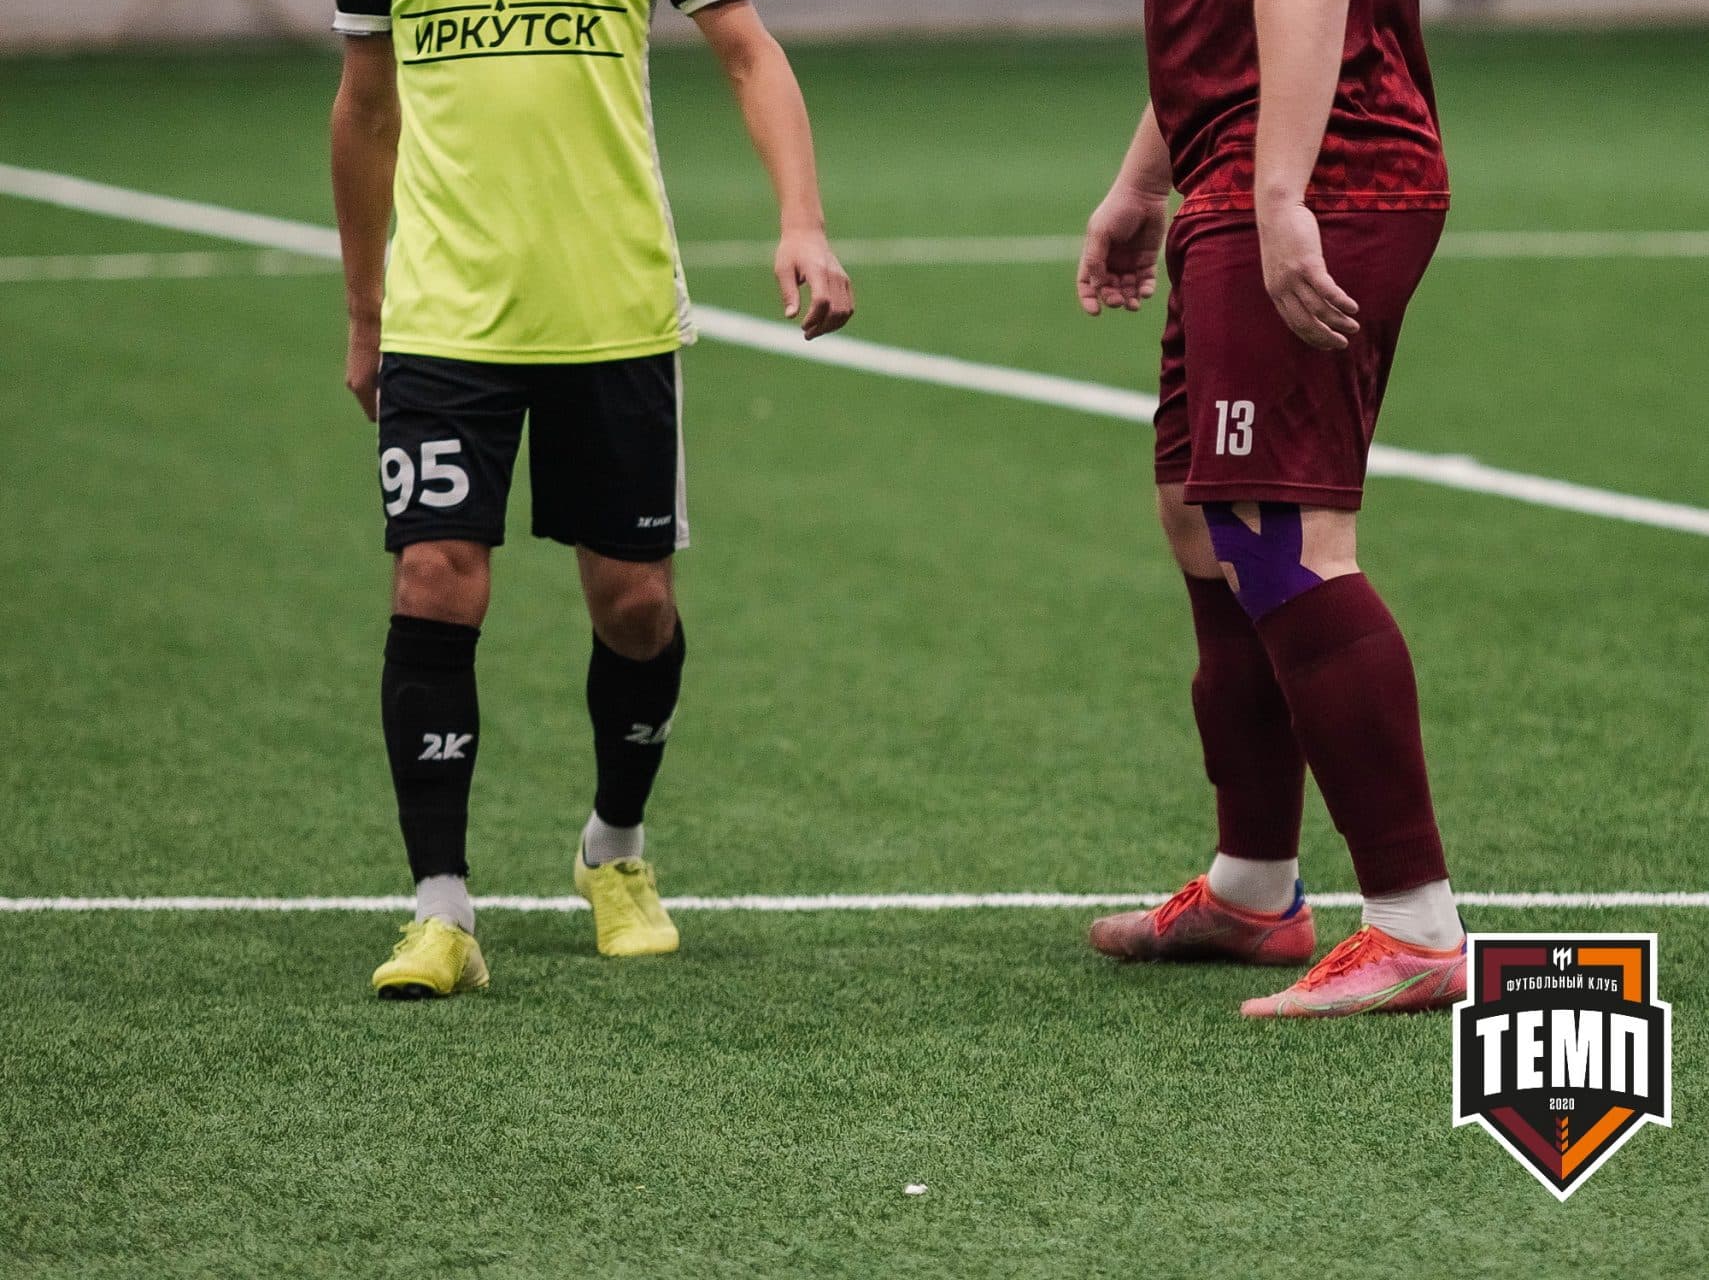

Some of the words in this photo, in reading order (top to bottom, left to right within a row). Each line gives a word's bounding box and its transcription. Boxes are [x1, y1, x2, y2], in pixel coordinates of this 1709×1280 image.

[415, 12, 602, 55] ИРКУТСК
[1215, 400, 1255, 456] 13
[381, 439, 470, 517] 95
[418, 733, 473, 760] 2K
